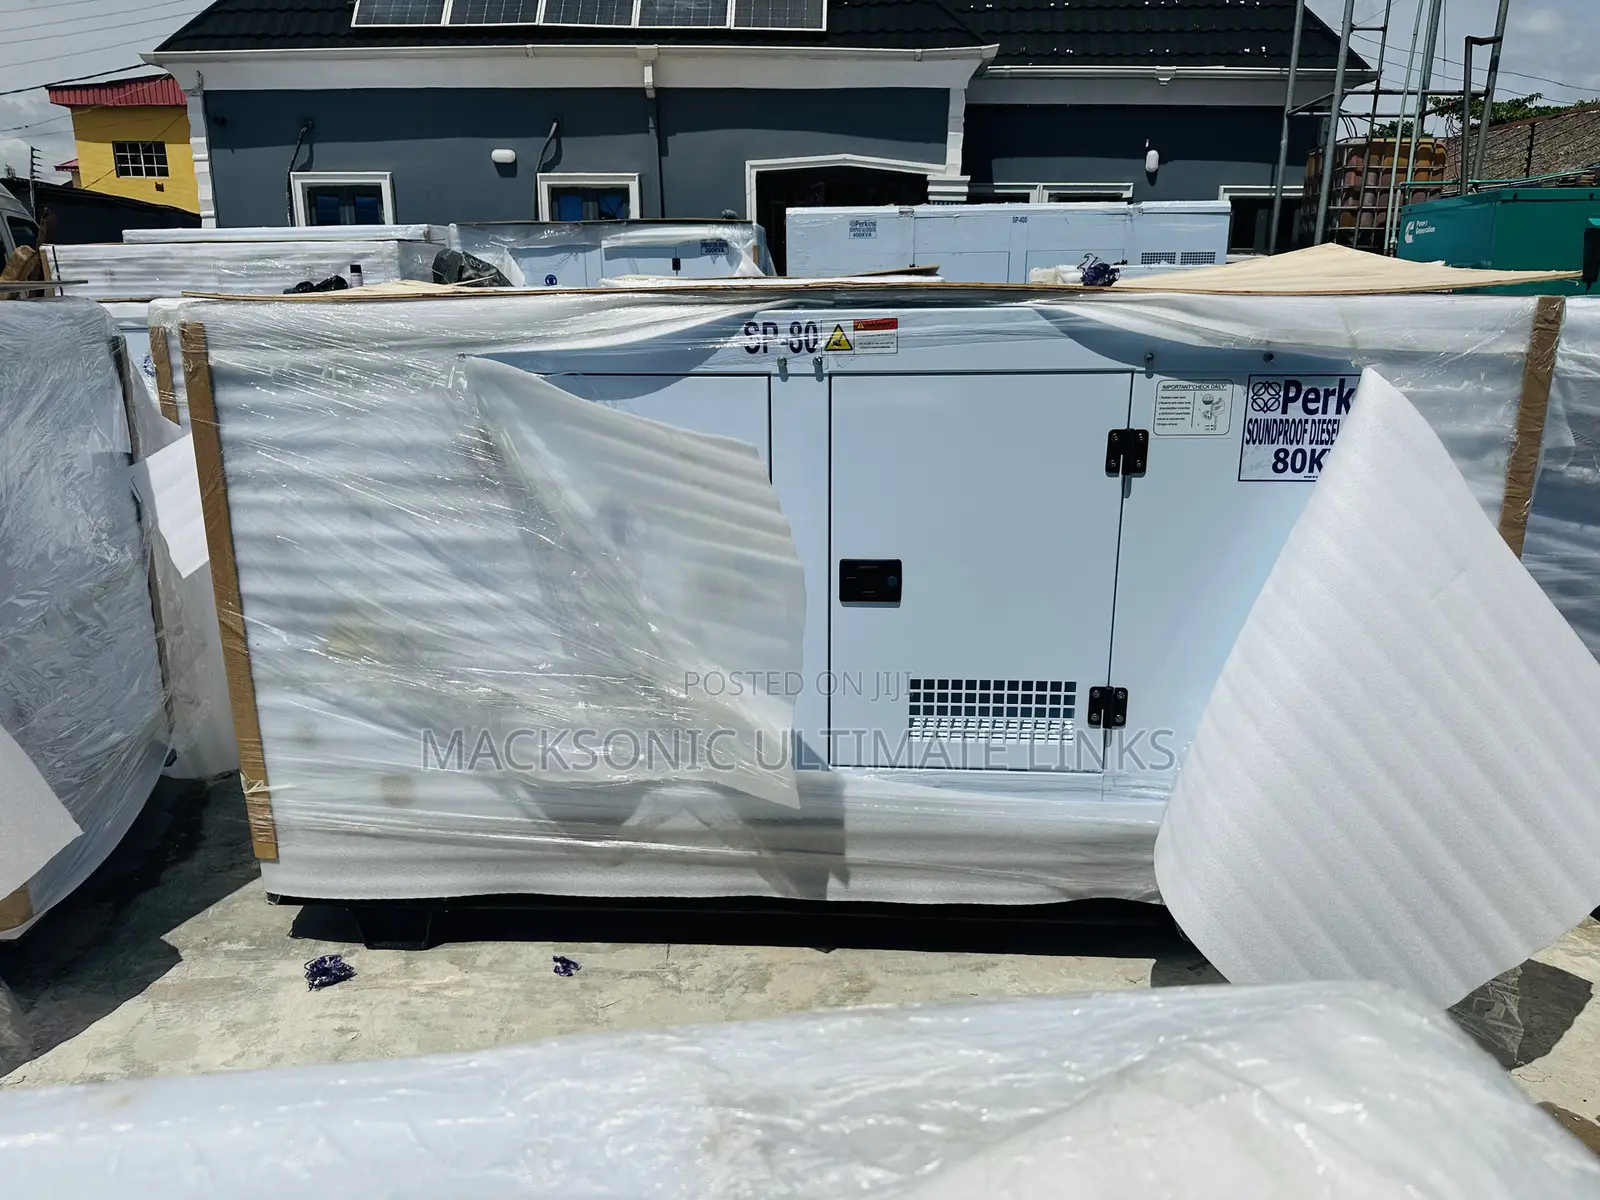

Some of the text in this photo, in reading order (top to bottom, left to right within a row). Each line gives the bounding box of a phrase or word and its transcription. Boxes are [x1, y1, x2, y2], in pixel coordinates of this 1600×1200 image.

[1281, 378, 1357, 415] Perk
[1245, 418, 1308, 445] SOUNDPROOF
[1272, 448, 1331, 474] 80K
